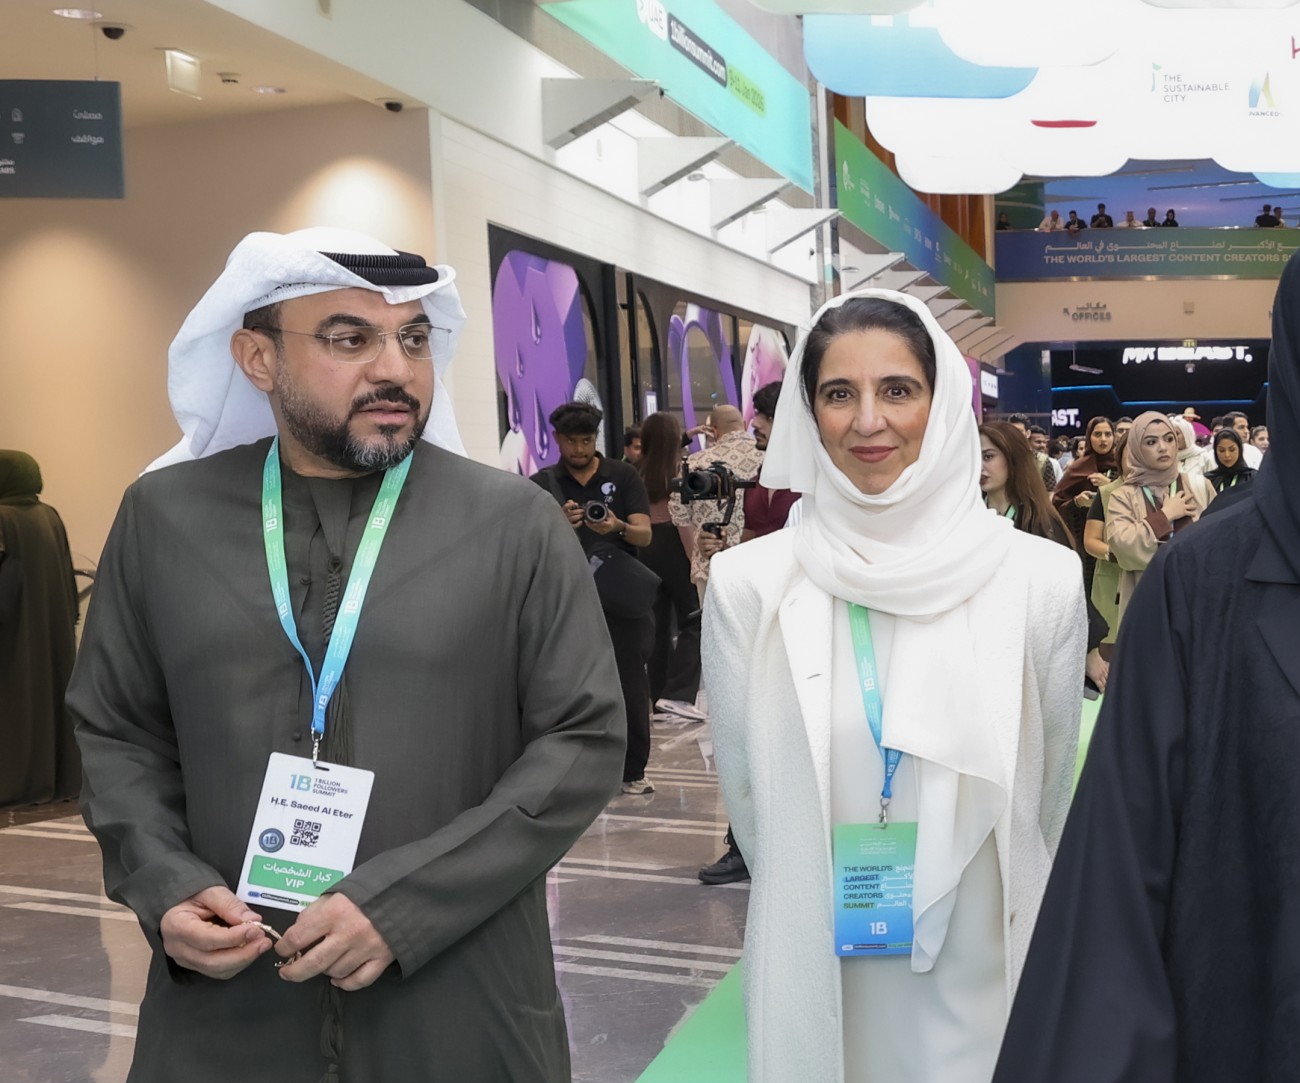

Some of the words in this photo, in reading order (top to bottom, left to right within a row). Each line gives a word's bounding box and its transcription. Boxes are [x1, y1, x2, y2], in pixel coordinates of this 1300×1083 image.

[670, 19, 726, 81] 1billionsummit.com
[1163, 74, 1182, 82] THE
[1163, 82, 1230, 93] SUSTAINABLE
[1163, 94, 1186, 103] CITY
[1044, 255, 1065, 264] THE
[1067, 254, 1115, 264] WORLD'S
[1117, 253, 1166, 263] LARGEST
[1168, 253, 1221, 262] CONTENT
[1223, 253, 1280, 262] CREATORS
[1072, 312, 1112, 321] OFFICES
[371, 515, 386, 530] 1B
[290, 774, 312, 792] 1B
[319, 778, 341, 788] BILLION
[312, 788, 336, 798] SUMMIT
[313, 783, 349, 795] FOLLOWERS
[271, 797, 288, 807] H.E.
[290, 800, 320, 813] Saeed
[321, 806, 332, 815] Al
[333, 809, 354, 820] Eter
[265, 835, 277, 845] 1B
[262, 861, 312, 879] الشخصيات
[285, 877, 305, 889] VIP
[313, 872, 332, 883] كبار
[844, 874, 880, 883] LARGEST
[843, 883, 880, 891] CONTENT
[843, 892, 883, 900] CREATORS
[869, 921, 888, 935] 1B
